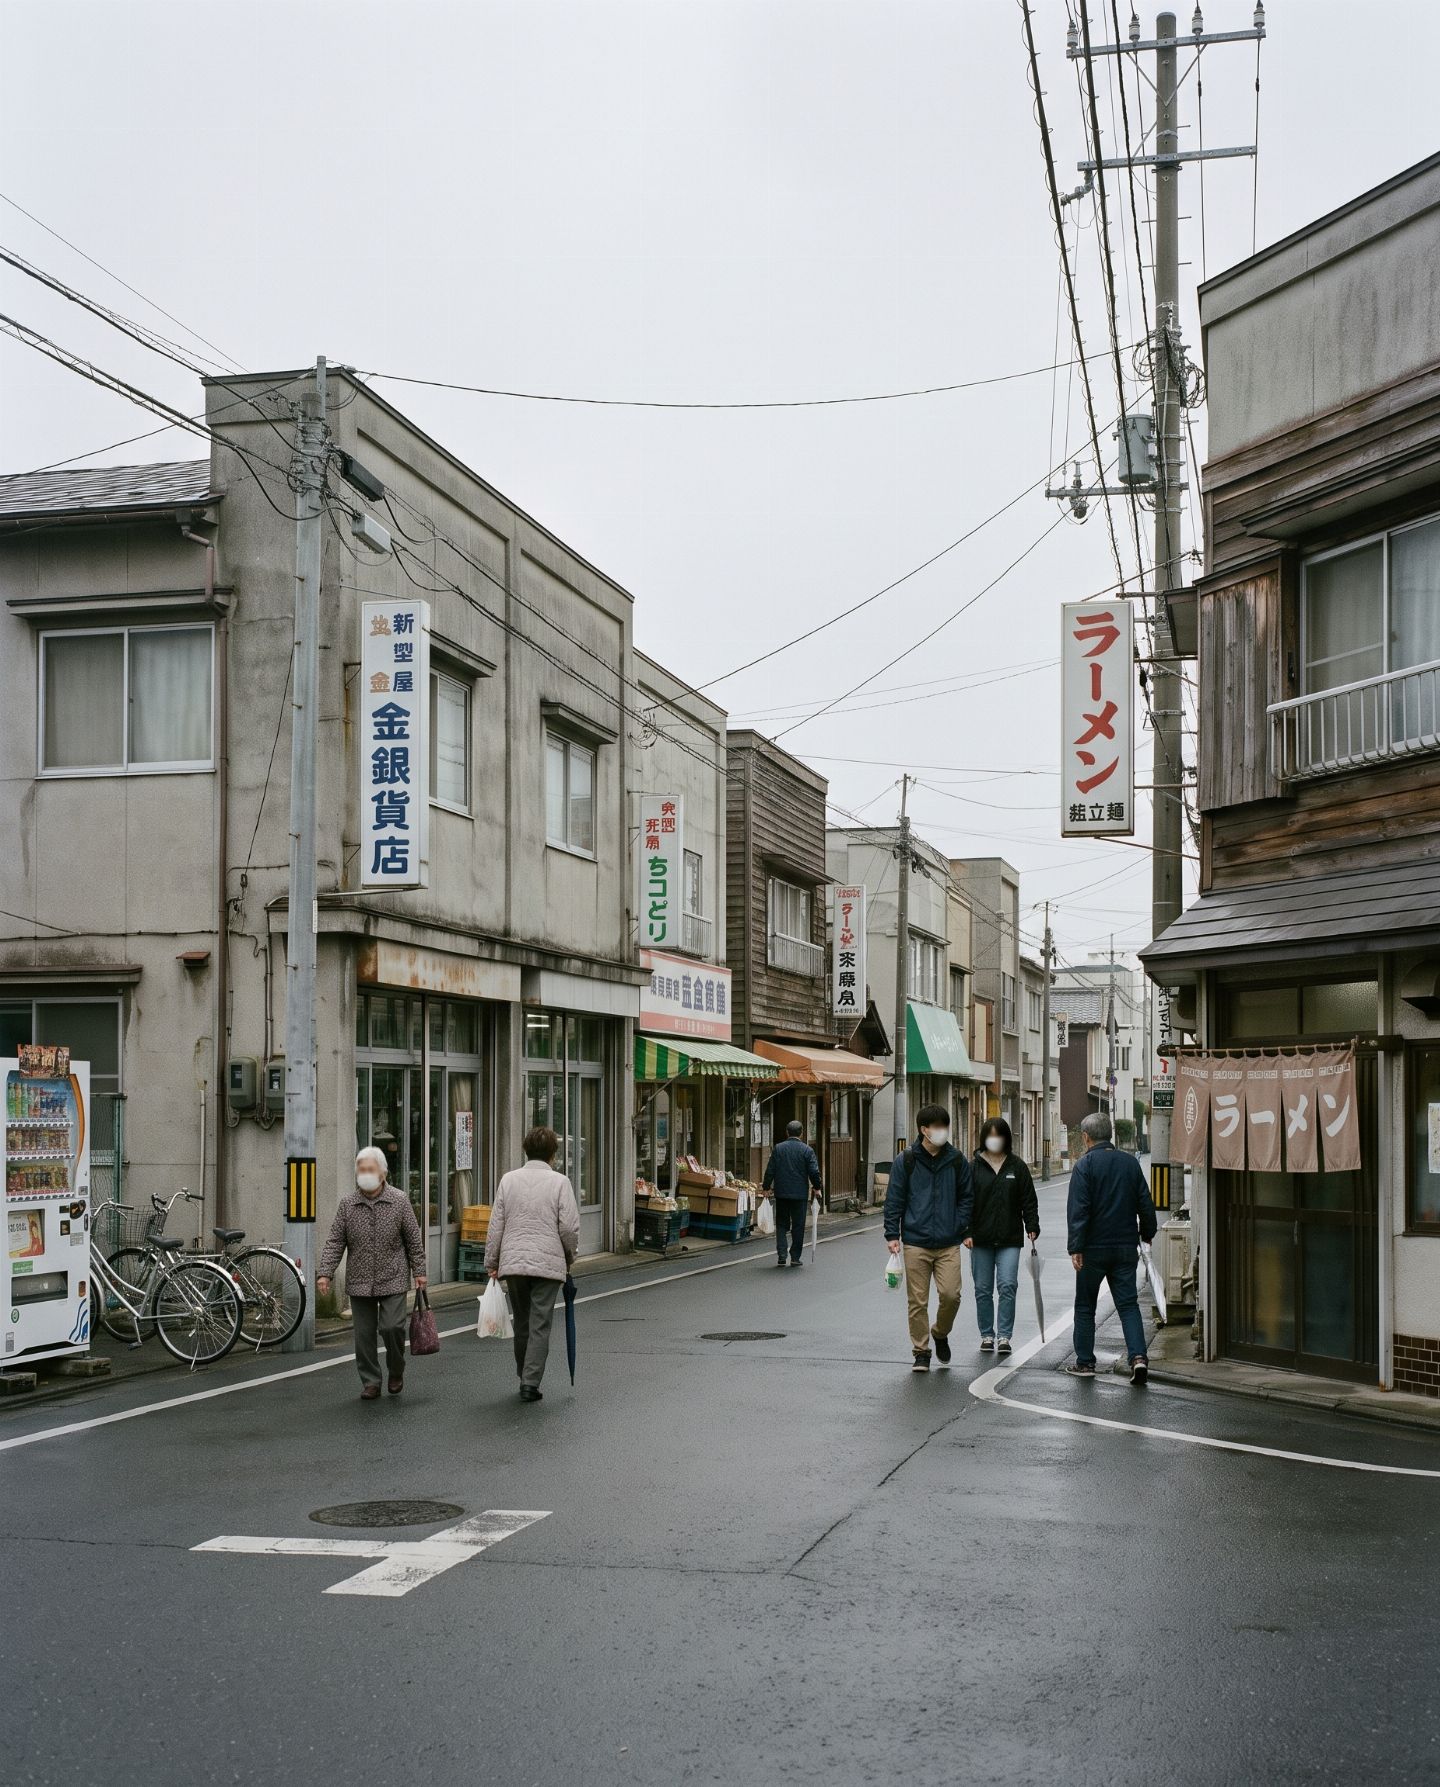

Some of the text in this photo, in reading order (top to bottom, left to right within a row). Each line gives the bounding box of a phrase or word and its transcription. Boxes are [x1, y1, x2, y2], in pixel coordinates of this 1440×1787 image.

[371, 701, 411, 875] 金銀貨店
[1073, 611, 1121, 795] ラーメン
[1214, 1093, 1350, 1138] ラーメン
